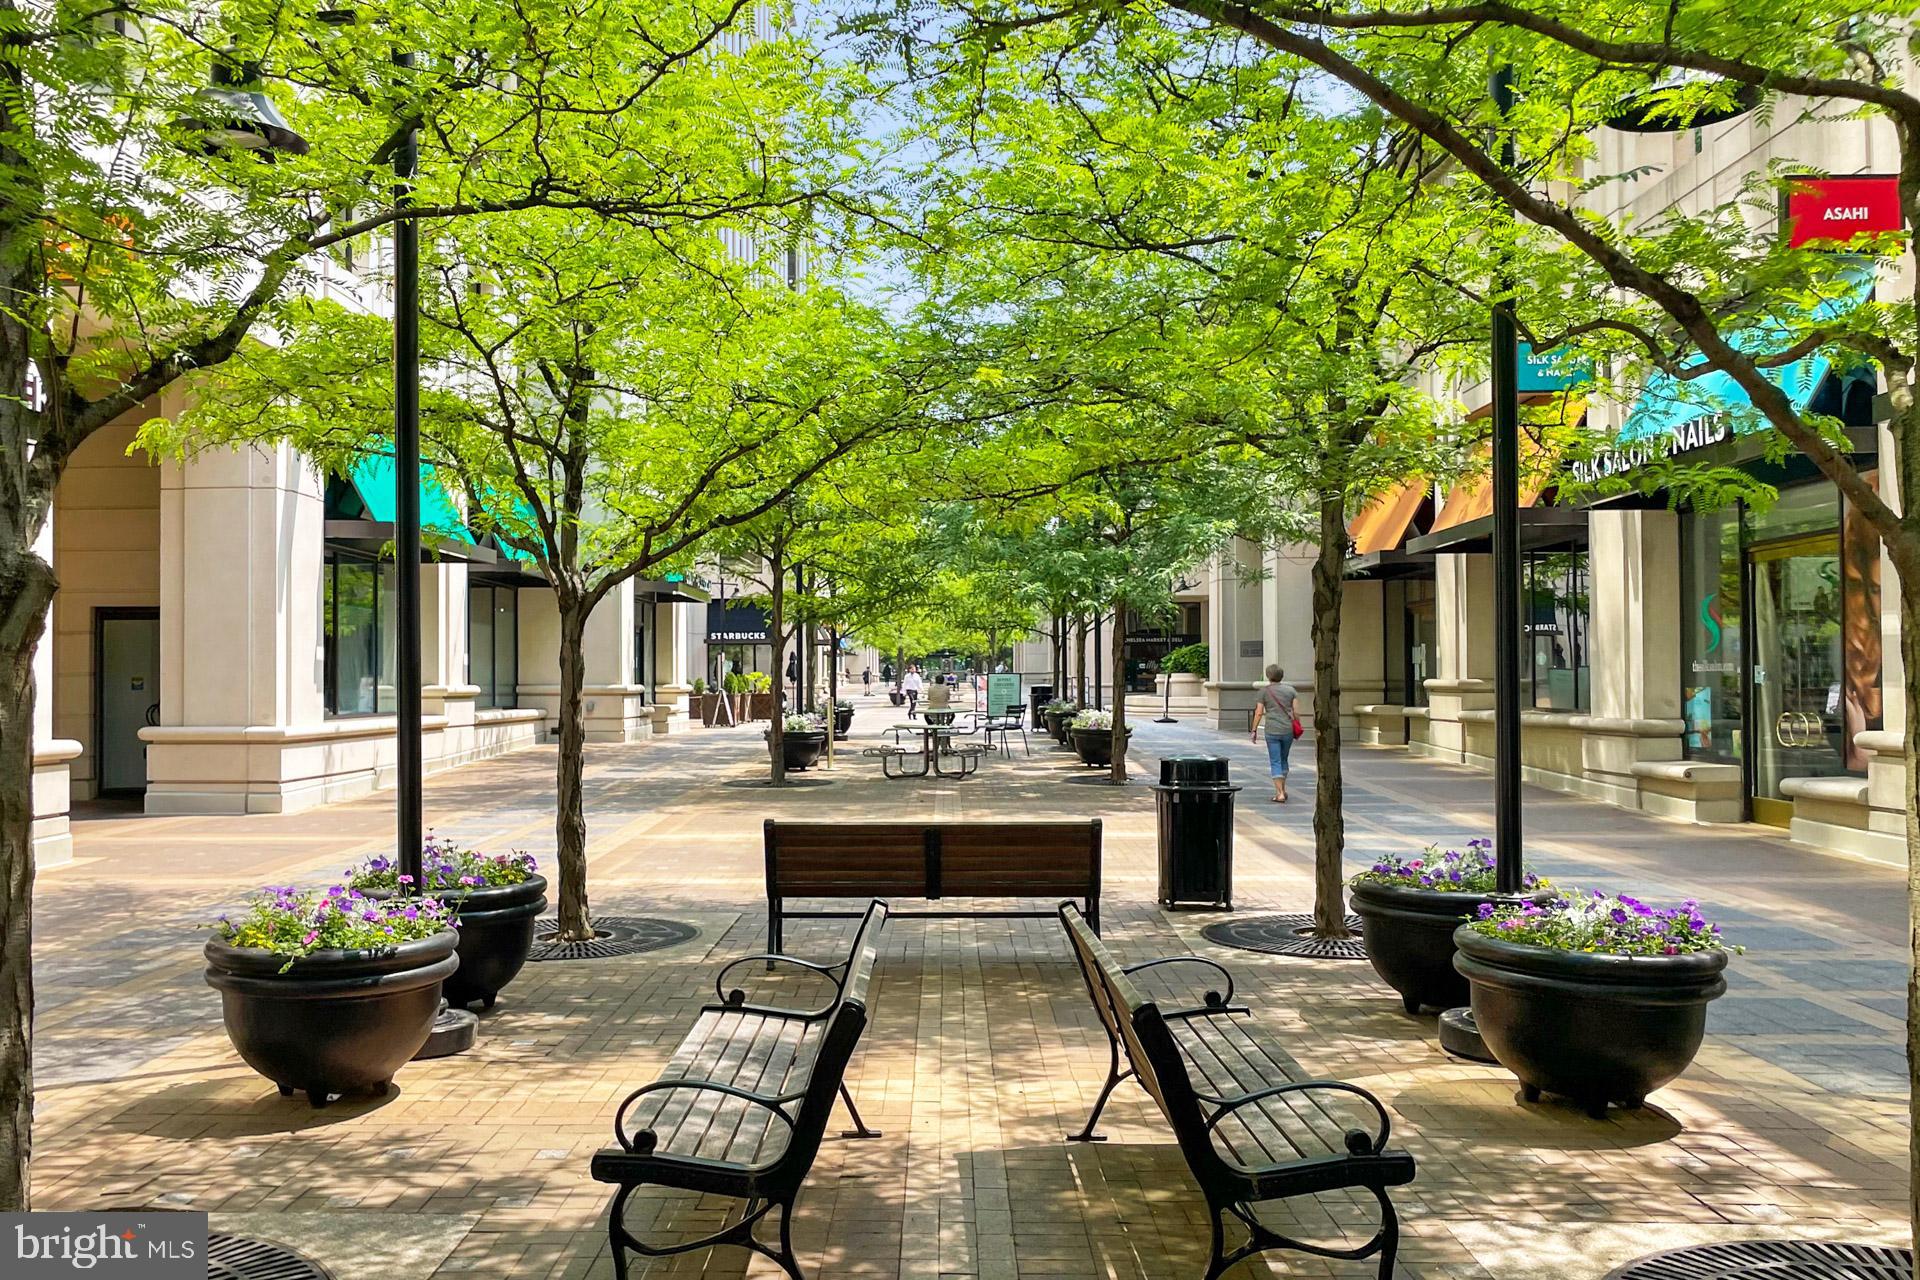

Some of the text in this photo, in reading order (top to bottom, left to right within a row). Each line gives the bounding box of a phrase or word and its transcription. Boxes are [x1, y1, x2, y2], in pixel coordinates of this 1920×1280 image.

[1823, 207, 1868, 220] ASAHI
[1527, 355, 1549, 365] SILK
[1537, 369, 1544, 377] &
[1572, 452, 1602, 483] SILK
[1672, 410, 1726, 455] NAILS
[711, 632, 766, 640] STARBUCKS
